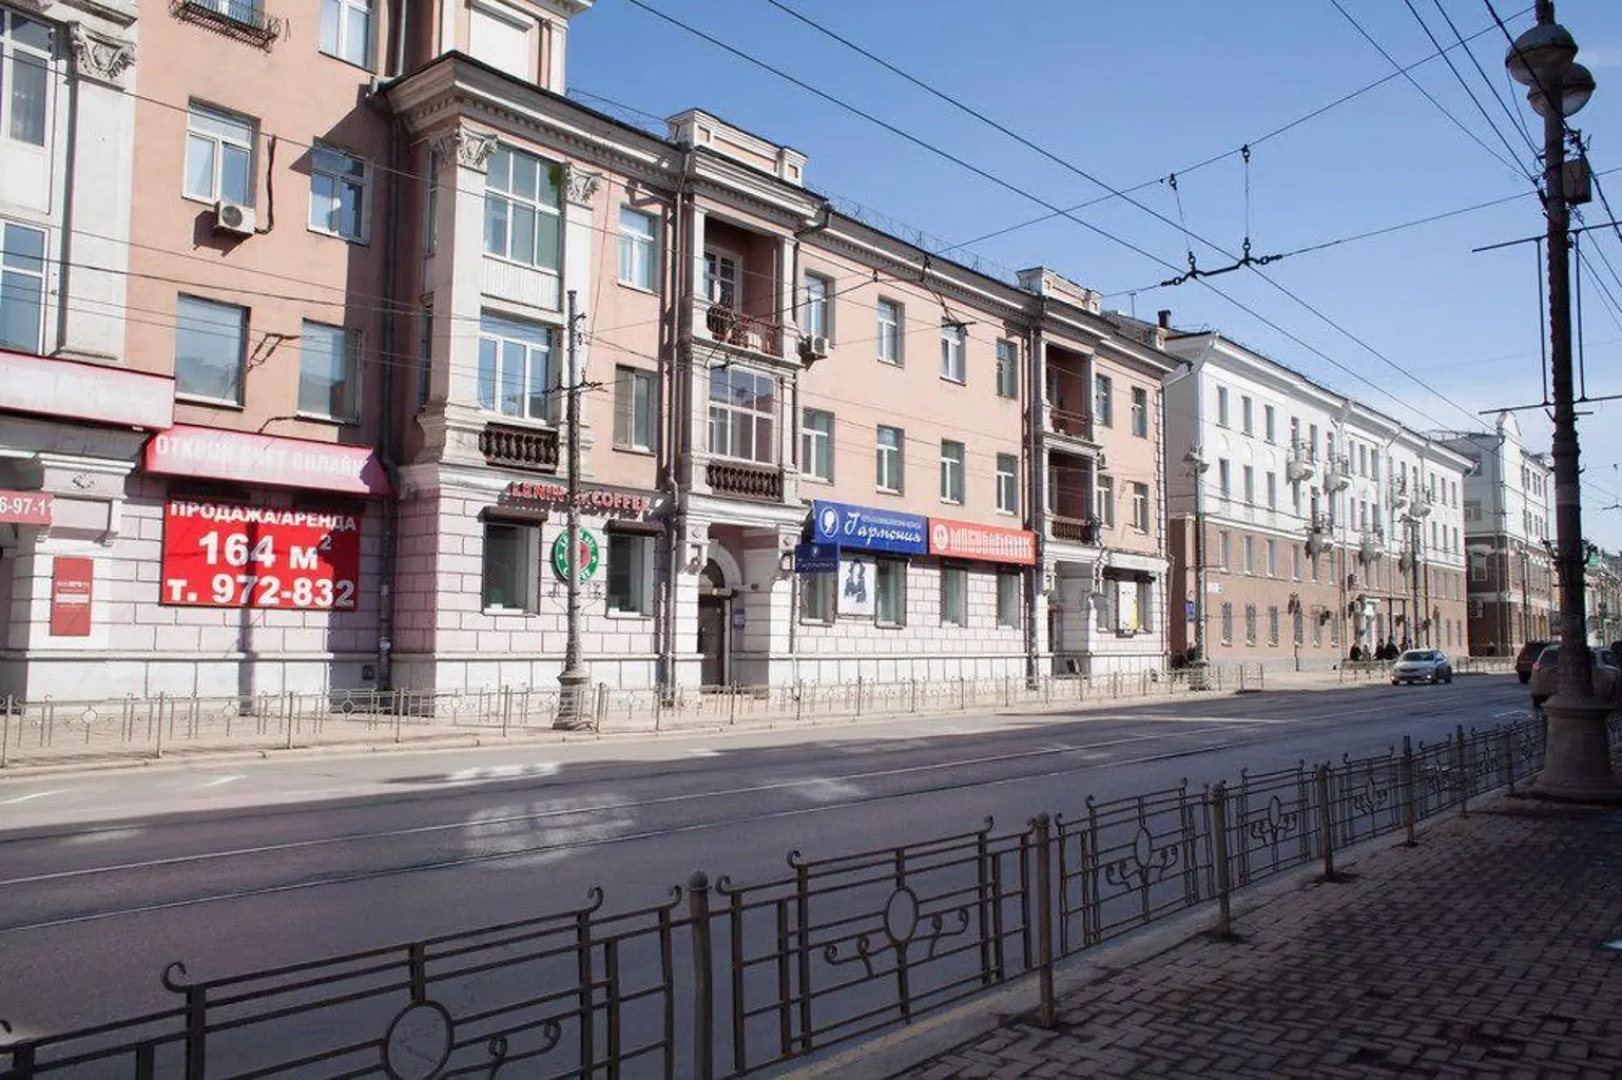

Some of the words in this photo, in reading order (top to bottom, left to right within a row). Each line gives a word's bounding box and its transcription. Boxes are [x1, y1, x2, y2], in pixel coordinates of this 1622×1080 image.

[170, 501, 357, 531] ПРОДАЖА/АРЕНДА
[199, 531, 277, 568] 164
[211, 573, 356, 607] 972-832
